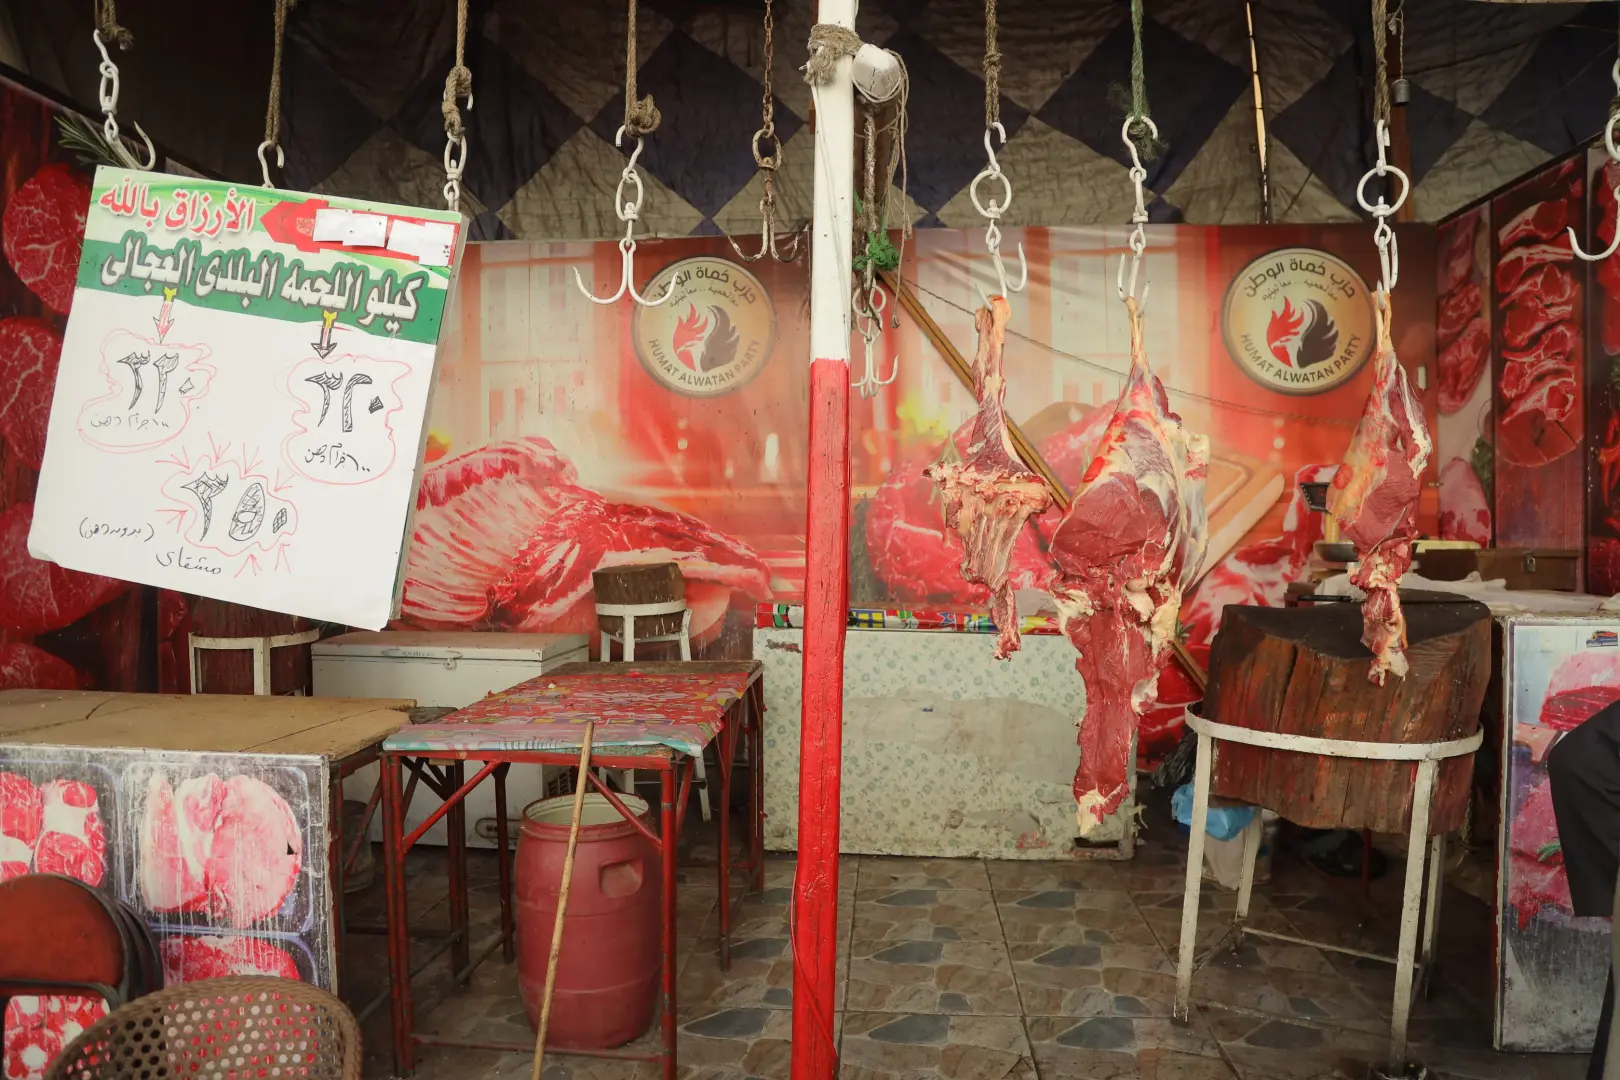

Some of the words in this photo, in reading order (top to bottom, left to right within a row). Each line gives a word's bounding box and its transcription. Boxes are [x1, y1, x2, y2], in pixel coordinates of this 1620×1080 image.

[100, 177, 160, 228] بالله
[164, 188, 256, 236] الأرزاق
[357, 276, 423, 332] كيلو
[653, 269, 691, 298] الوط
[733, 280, 756, 304] حزب
[1243, 262, 1285, 298] الوطن
[1330, 273, 1356, 299] حزب
[648, 338, 679, 376] HUMAT
[678, 368, 735, 387] ALWATAN
[733, 339, 760, 374] PARTY
[1241, 333, 1275, 373] HUMAT
[1273, 366, 1335, 384] ALWATAN
[1333, 333, 1361, 371] PARTY
